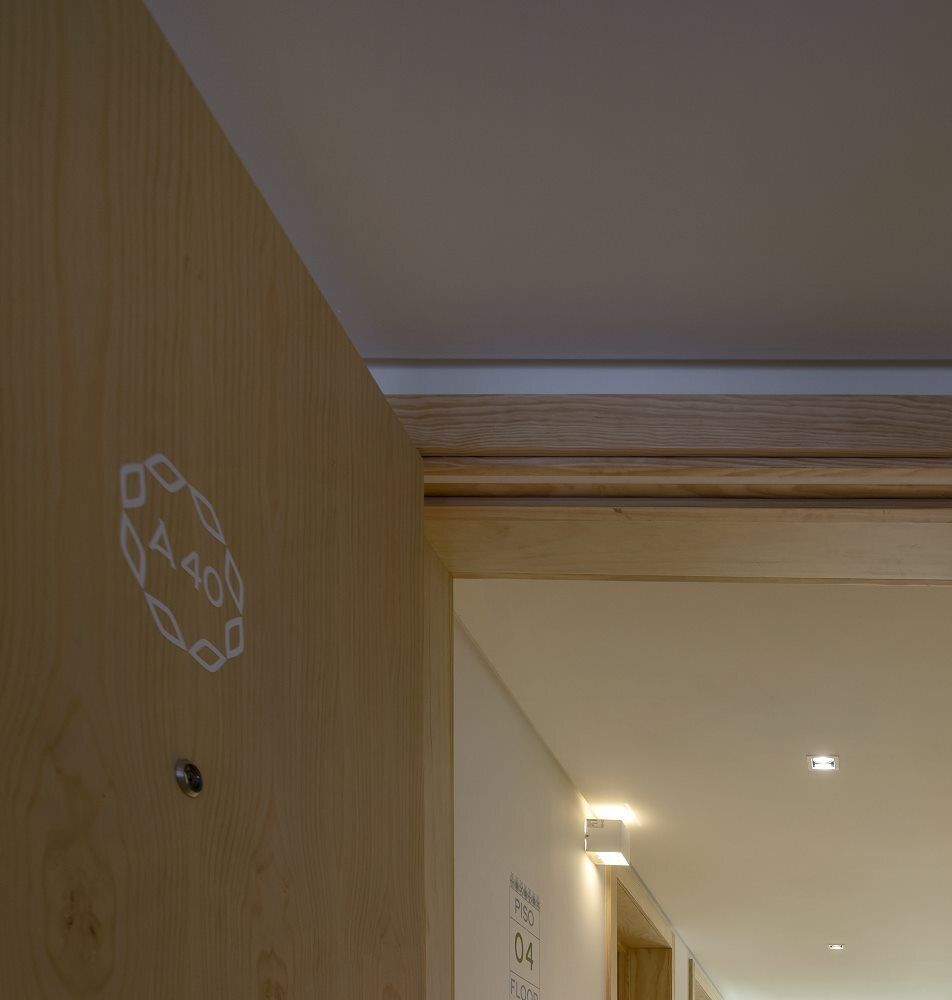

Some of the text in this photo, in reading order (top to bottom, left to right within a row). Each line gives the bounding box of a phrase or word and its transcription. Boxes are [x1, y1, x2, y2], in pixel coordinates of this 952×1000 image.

[149, 518, 224, 608] A40
[514, 898, 535, 927] PISO
[514, 932, 534, 971] 04
